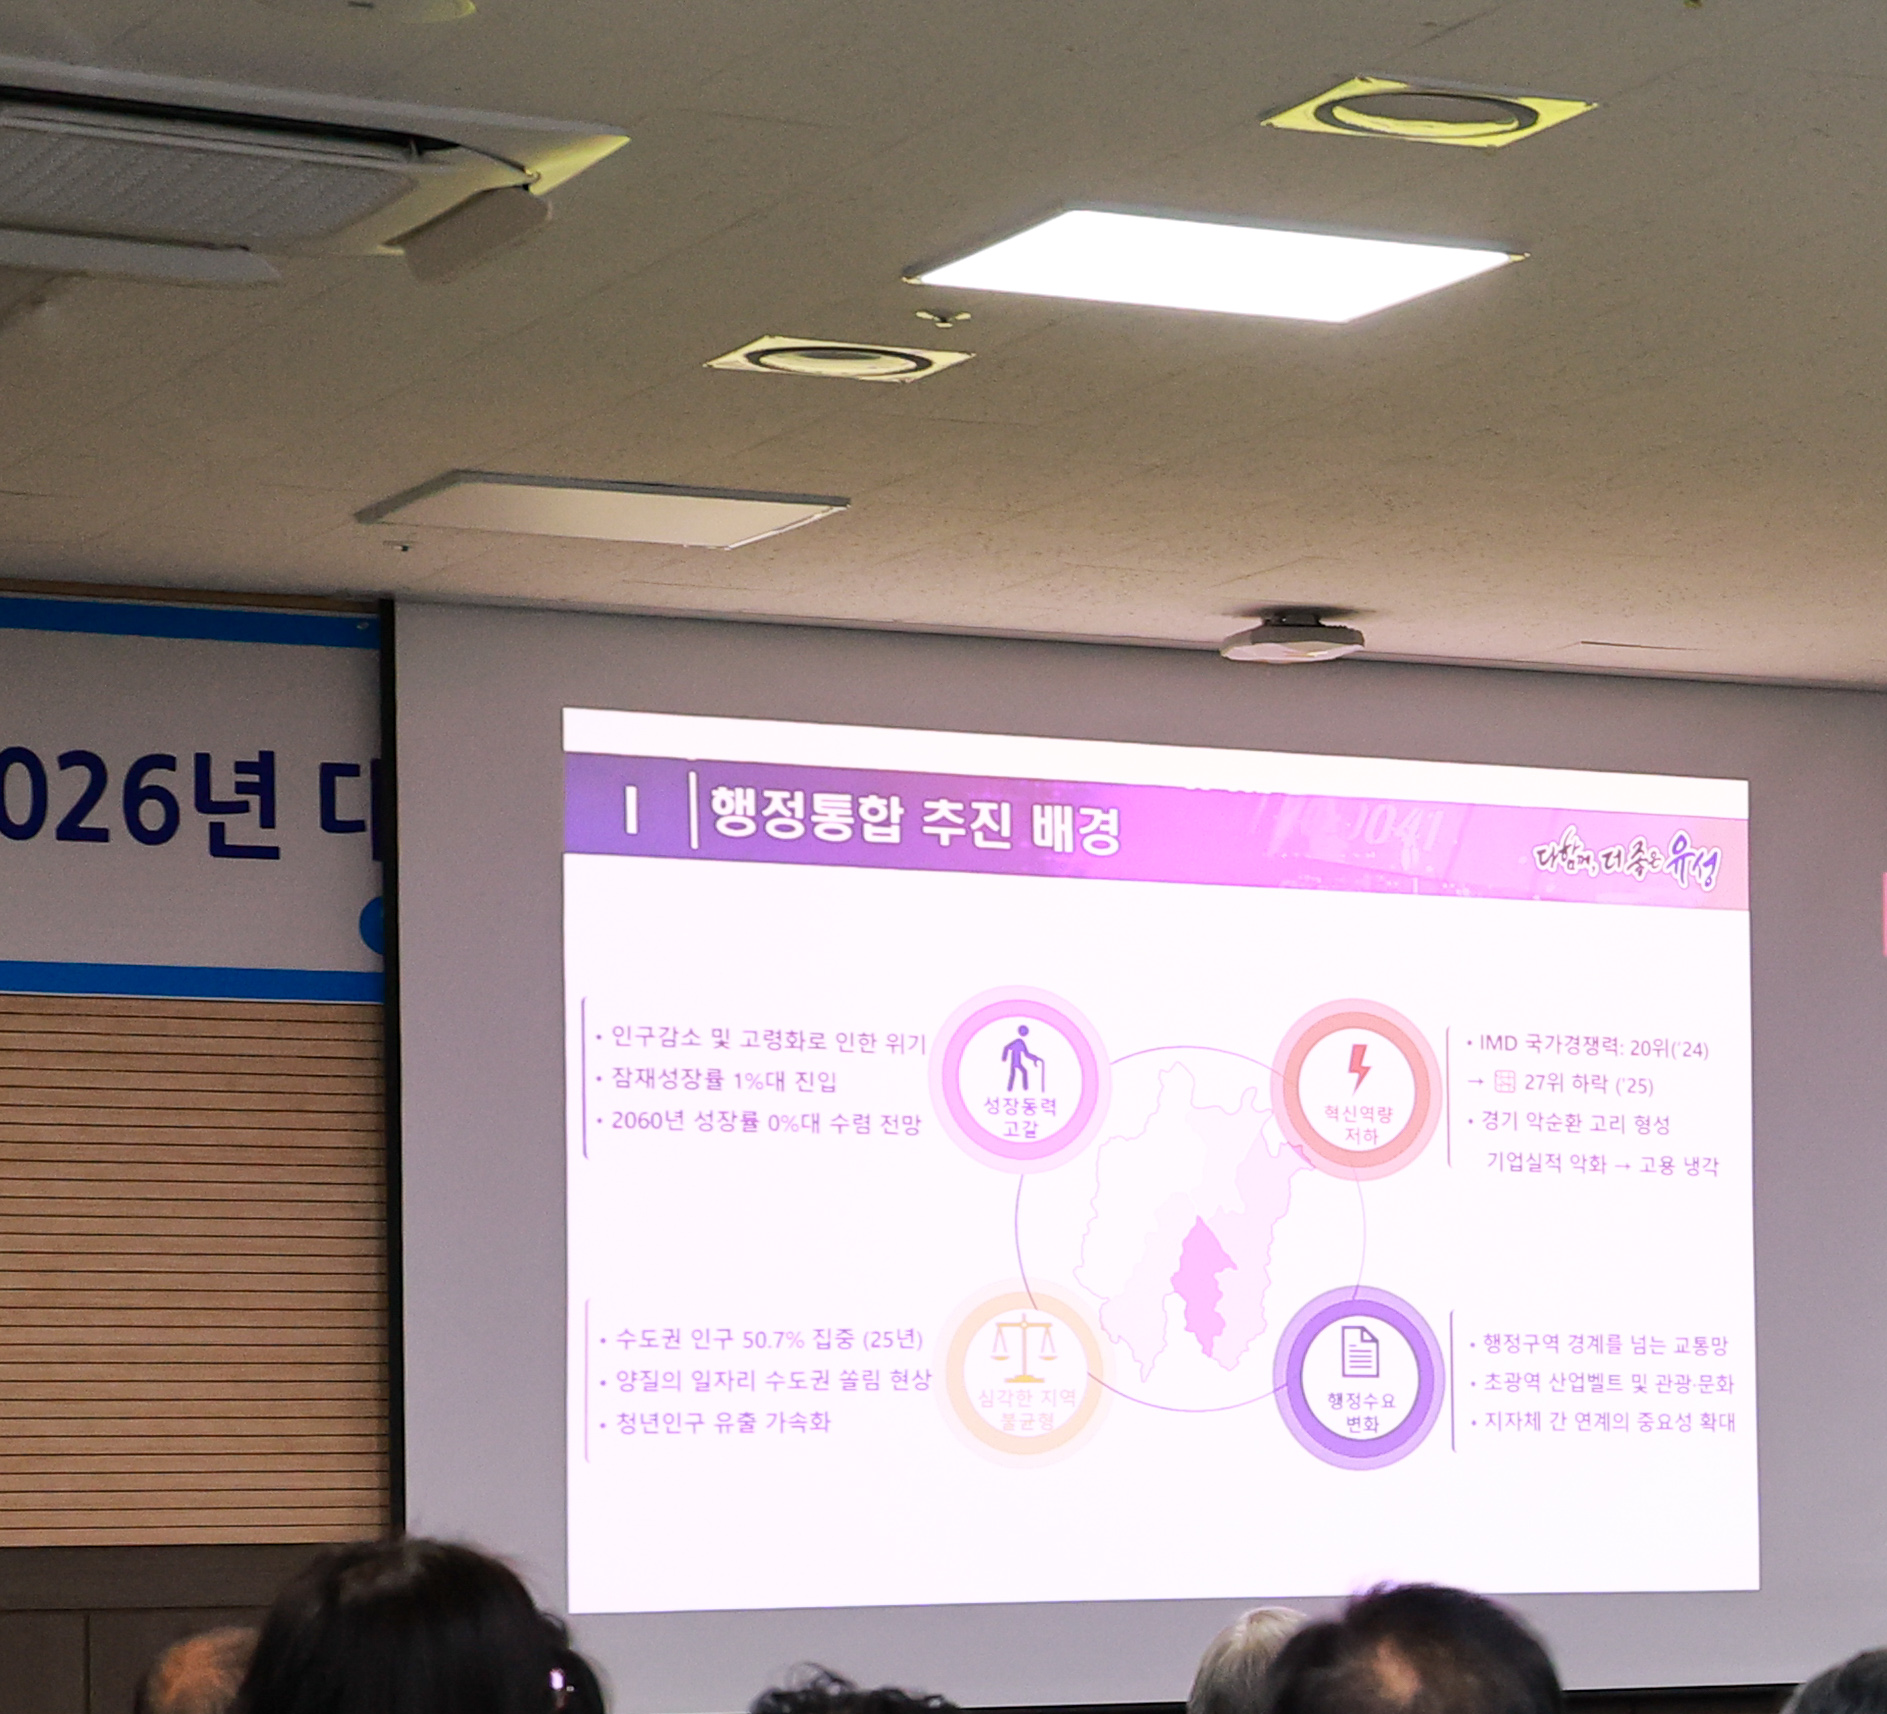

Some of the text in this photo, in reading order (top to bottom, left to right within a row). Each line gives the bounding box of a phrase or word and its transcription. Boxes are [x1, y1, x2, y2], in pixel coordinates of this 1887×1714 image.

[710, 784, 1121, 856] 행정통합 추진 배경
[1626, 840, 1661, 877] 좋은
[1667, 834, 1718, 887] 유성
[612, 1026, 925, 1055] 인구감소 및 고령화로 인한 위기
[1481, 1035, 1518, 1051] IMD
[613, 1067, 836, 1093] 잠재성장률 1%대 진입
[1525, 1073, 1563, 1093] 27위
[1572, 1073, 1608, 1094] 하락
[984, 1096, 1058, 1117] 성장동력
[1324, 1104, 1393, 1126] 혁신역량
[612, 1110, 922, 1136] 2060년 성장률 0%대 수렴 전망
[1004, 1118, 1039, 1140] 고갈
[1483, 1111, 1669, 1135] 경기 악순환 고리 형성
[1345, 1128, 1379, 1145] 저하
[1488, 1152, 1719, 1177] 기업실적 악화 고용 냉각
[616, 1328, 680, 1350] 수도권
[691, 1328, 734, 1350] 인구
[743, 1331, 805, 1349] 50.7%
[813, 1328, 855, 1350] 집중
[1484, 1333, 1728, 1356] 행정구역 경계를 넘는 교통망
[616, 1369, 933, 1392] 양질의 일자리 수도권 쏠림 현상
[1485, 1372, 1540, 1393] 초광역
[1549, 1372, 1623, 1393] 산업벨트
[1632, 1374, 1647, 1394] 및
[1327, 1390, 1397, 1412] 행정수요
[617, 1411, 831, 1435] 청년인구 유출 가속화
[1345, 1415, 1380, 1434] 변화
[1486, 1411, 1735, 1433] 지자체 간 연계의 중요성 확대
